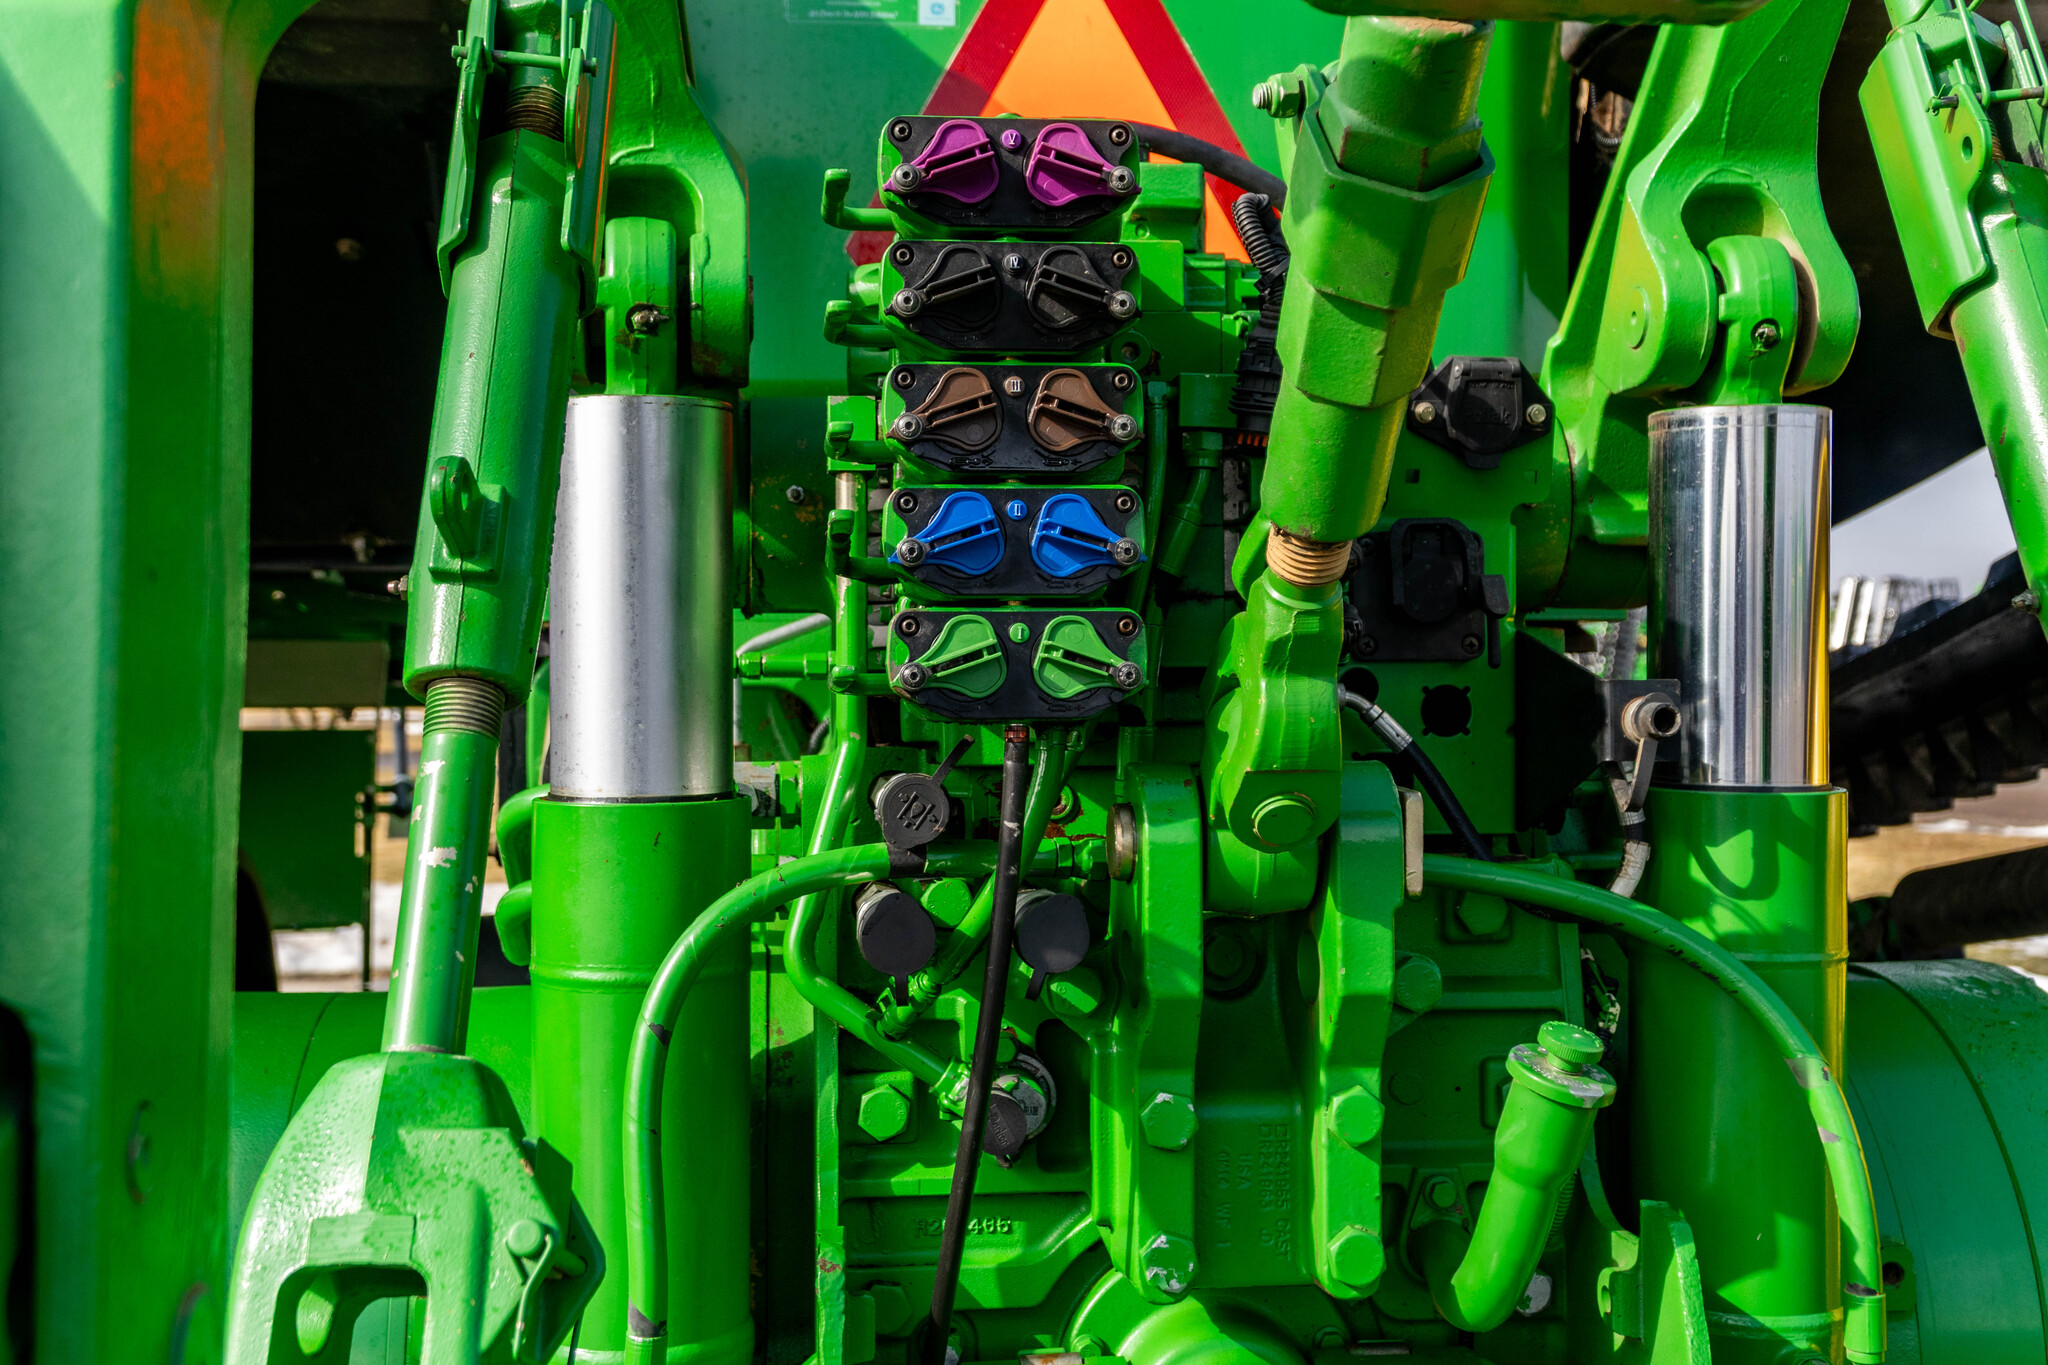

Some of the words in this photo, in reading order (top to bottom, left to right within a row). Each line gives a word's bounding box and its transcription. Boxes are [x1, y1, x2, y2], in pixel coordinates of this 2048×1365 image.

[1008, 132, 1016, 145] V
[1010, 256, 1020, 269] IV
[1010, 380, 1021, 393] III
[1013, 503, 1022, 517] II
[1237, 1152, 1253, 1190] USA
[1275, 1218, 1292, 1262] CAST
